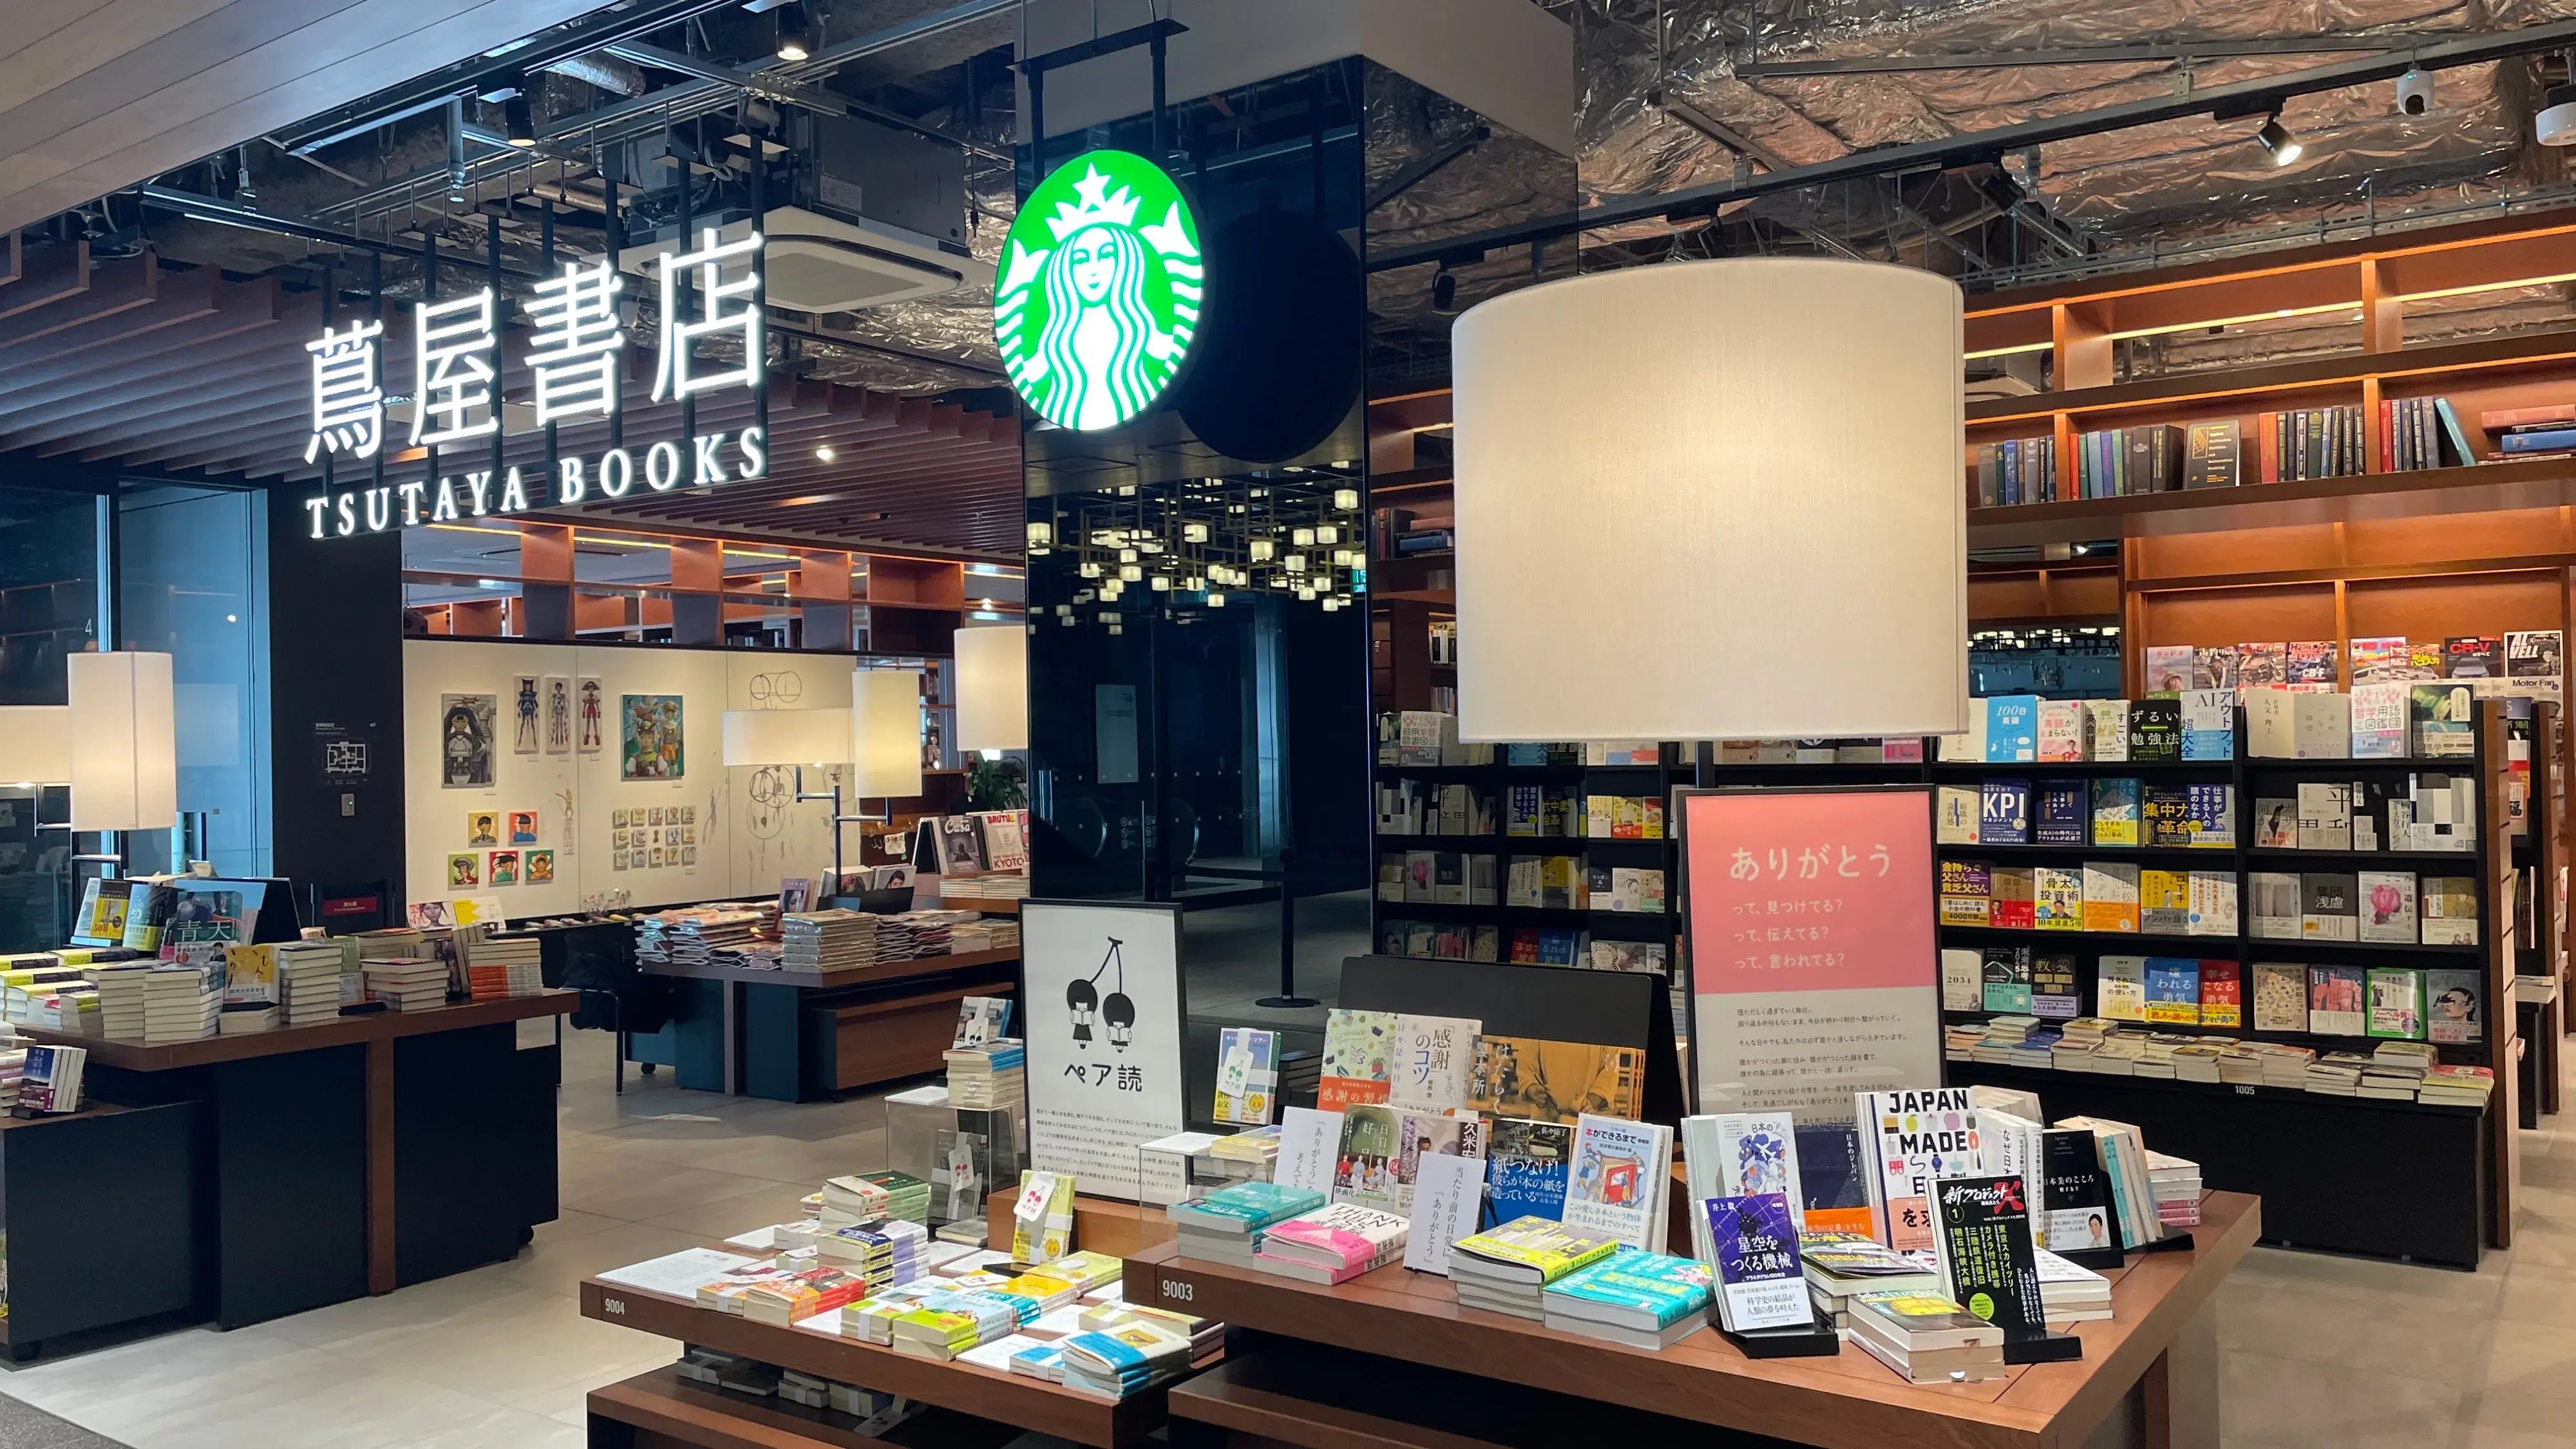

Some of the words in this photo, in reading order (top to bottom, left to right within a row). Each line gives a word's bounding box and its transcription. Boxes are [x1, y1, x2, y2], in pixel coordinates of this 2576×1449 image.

[305, 227, 763, 464] 蔦屋書店
[306, 466, 528, 540] TSUTAYA
[559, 426, 765, 505] BOOKS
[2449, 642, 2490, 654] CR-V
[2195, 692, 2217, 708] AI
[2131, 709, 2179, 723] ずるい
[2131, 732, 2179, 746] 勉強法
[2181, 718, 2194, 758] 超大全
[1983, 793, 2025, 818] KPI
[2201, 786, 2211, 828] できる人の
[2213, 786, 2222, 811] 仕事が
[945, 819, 971, 835] Casa
[994, 857, 1025, 869] KYOTO
[1729, 843, 1891, 882] ありがとう
[1942, 873, 1969, 882] 父さん
[2157, 978, 2192, 990] われる
[1412, 1034, 1430, 1086] のコツ
[1064, 1063, 1143, 1093] ペア読
[2235, 1085, 2255, 1095] 1005
[1889, 1089, 1969, 1113] JAPAN
[1585, 1128, 1636, 1144] 本ができるまで
[1900, 1130, 1968, 1155] MADE
[1952, 1208, 1958, 1219] 1
[1738, 1235, 1778, 1254] 星空を
[1731, 1251, 1794, 1272] つくる機械
[1998, 1224, 2014, 1296] 東京スカイツリー
[1162, 1279, 1193, 1301] 9003
[605, 1298, 625, 1316] 9004
